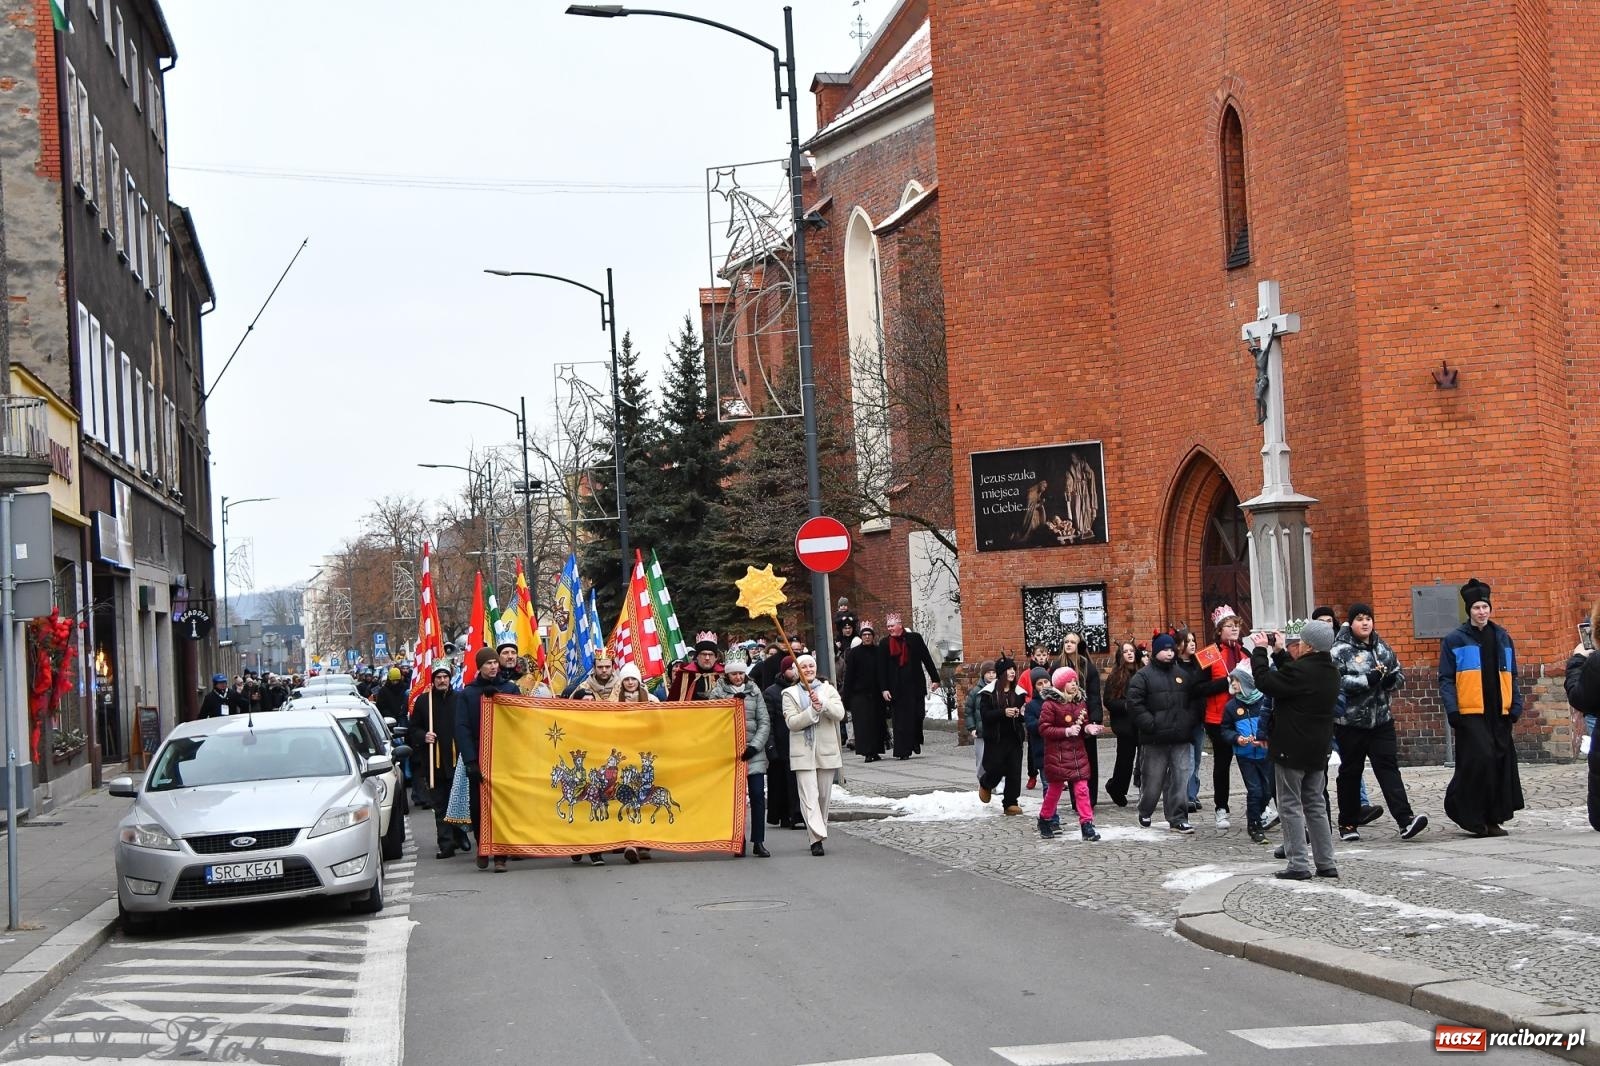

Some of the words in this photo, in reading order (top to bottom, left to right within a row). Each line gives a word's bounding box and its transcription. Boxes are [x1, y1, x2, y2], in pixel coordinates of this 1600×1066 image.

[980, 474, 1006, 486] Jezus
[1007, 469, 1036, 482] szuka
[981, 487, 1020, 500] miejsca
[983, 507, 990, 515] u
[215, 865, 241, 880] SRC
[246, 861, 279, 877] KE61
